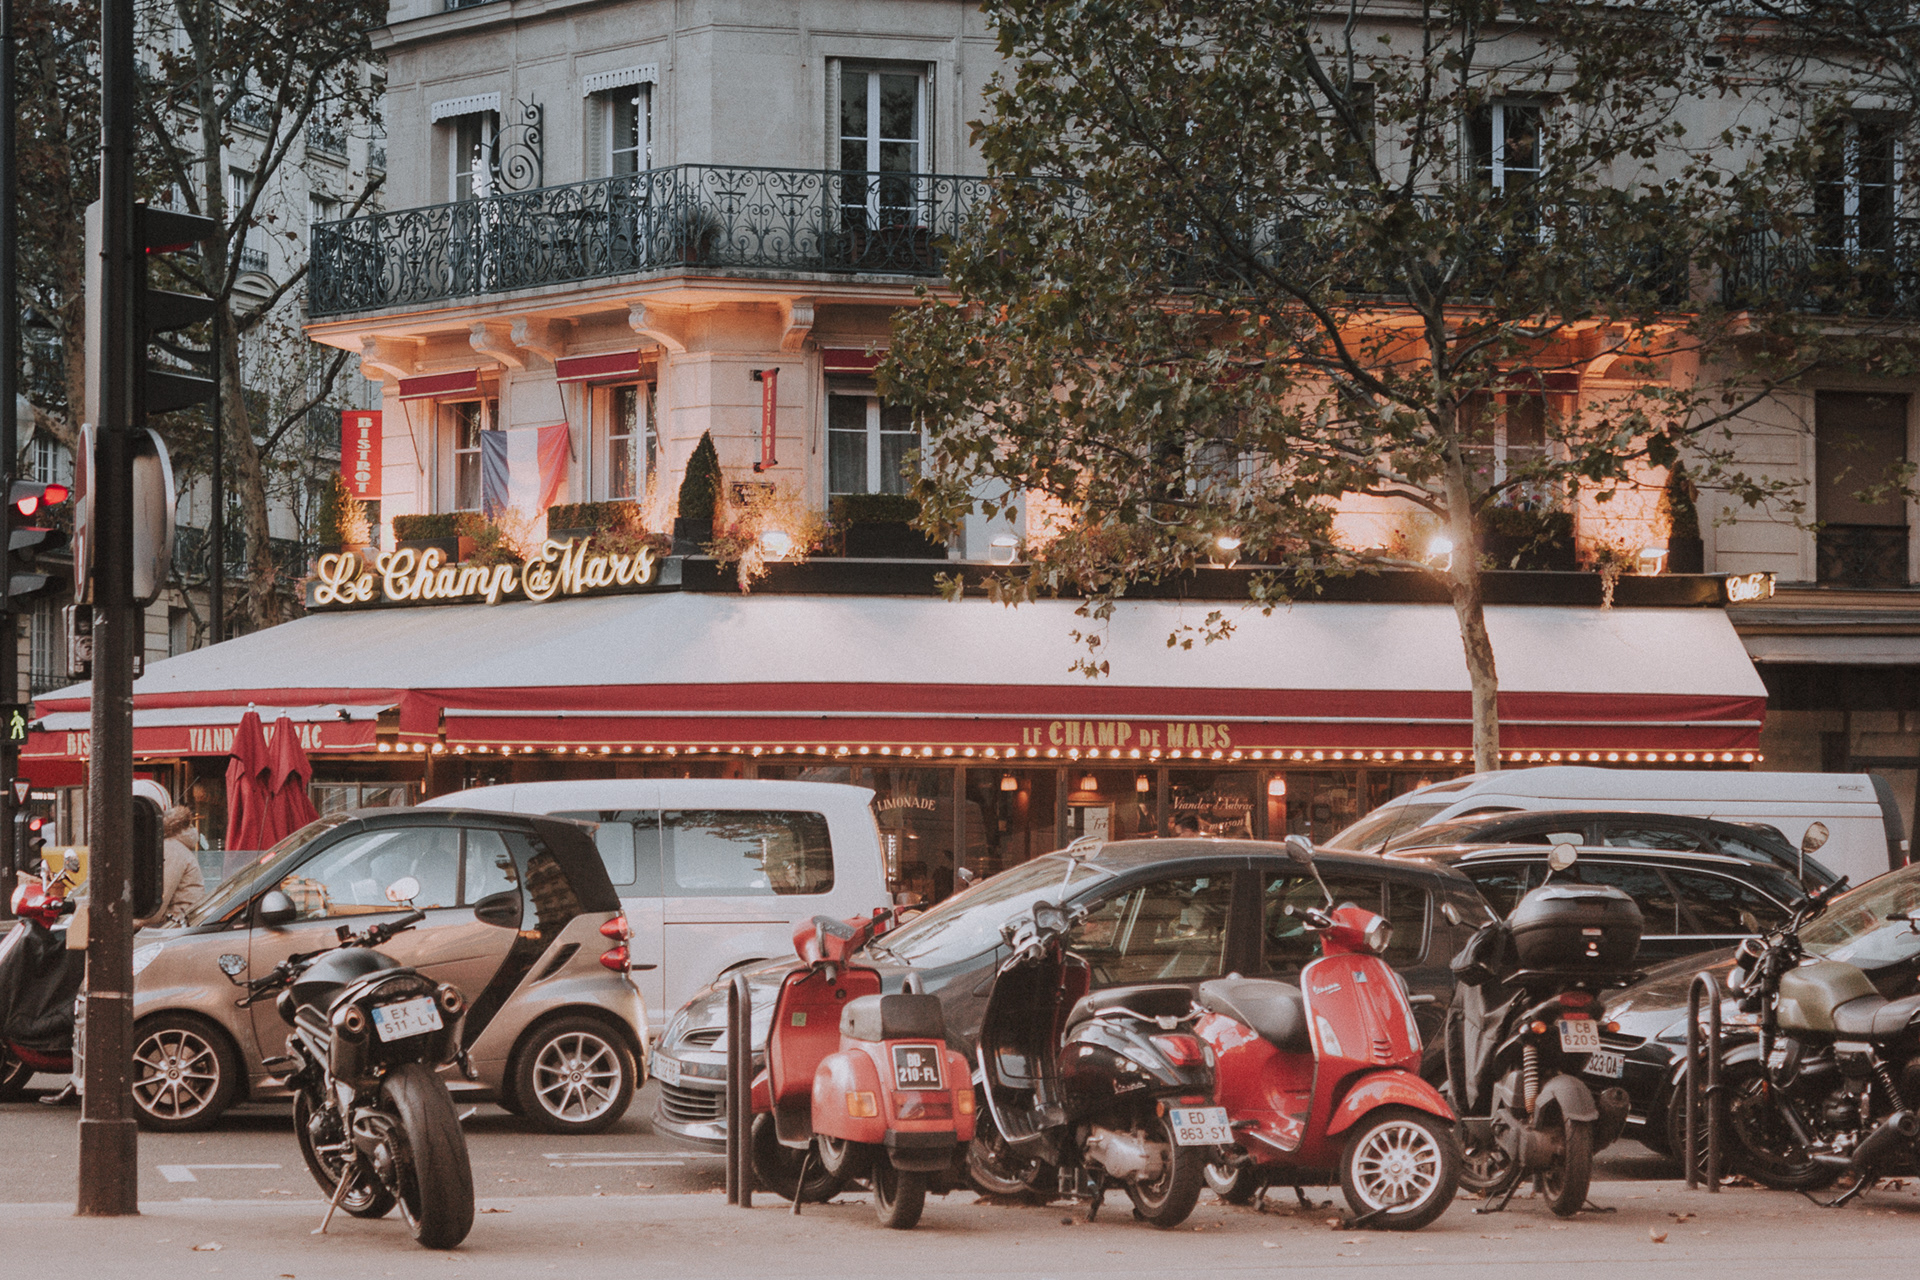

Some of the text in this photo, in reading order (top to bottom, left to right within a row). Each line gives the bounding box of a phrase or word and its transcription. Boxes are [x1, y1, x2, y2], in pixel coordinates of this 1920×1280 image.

[764, 376, 772, 460] BISTROT
[354, 417, 373, 493] BISTROT
[314, 552, 374, 605] Le
[376, 547, 518, 606] Champ
[542, 536, 655, 595] Mars
[1023, 721, 1231, 749] LE CHAMP DE MARS
[877, 796, 936, 812] LIMONADE
